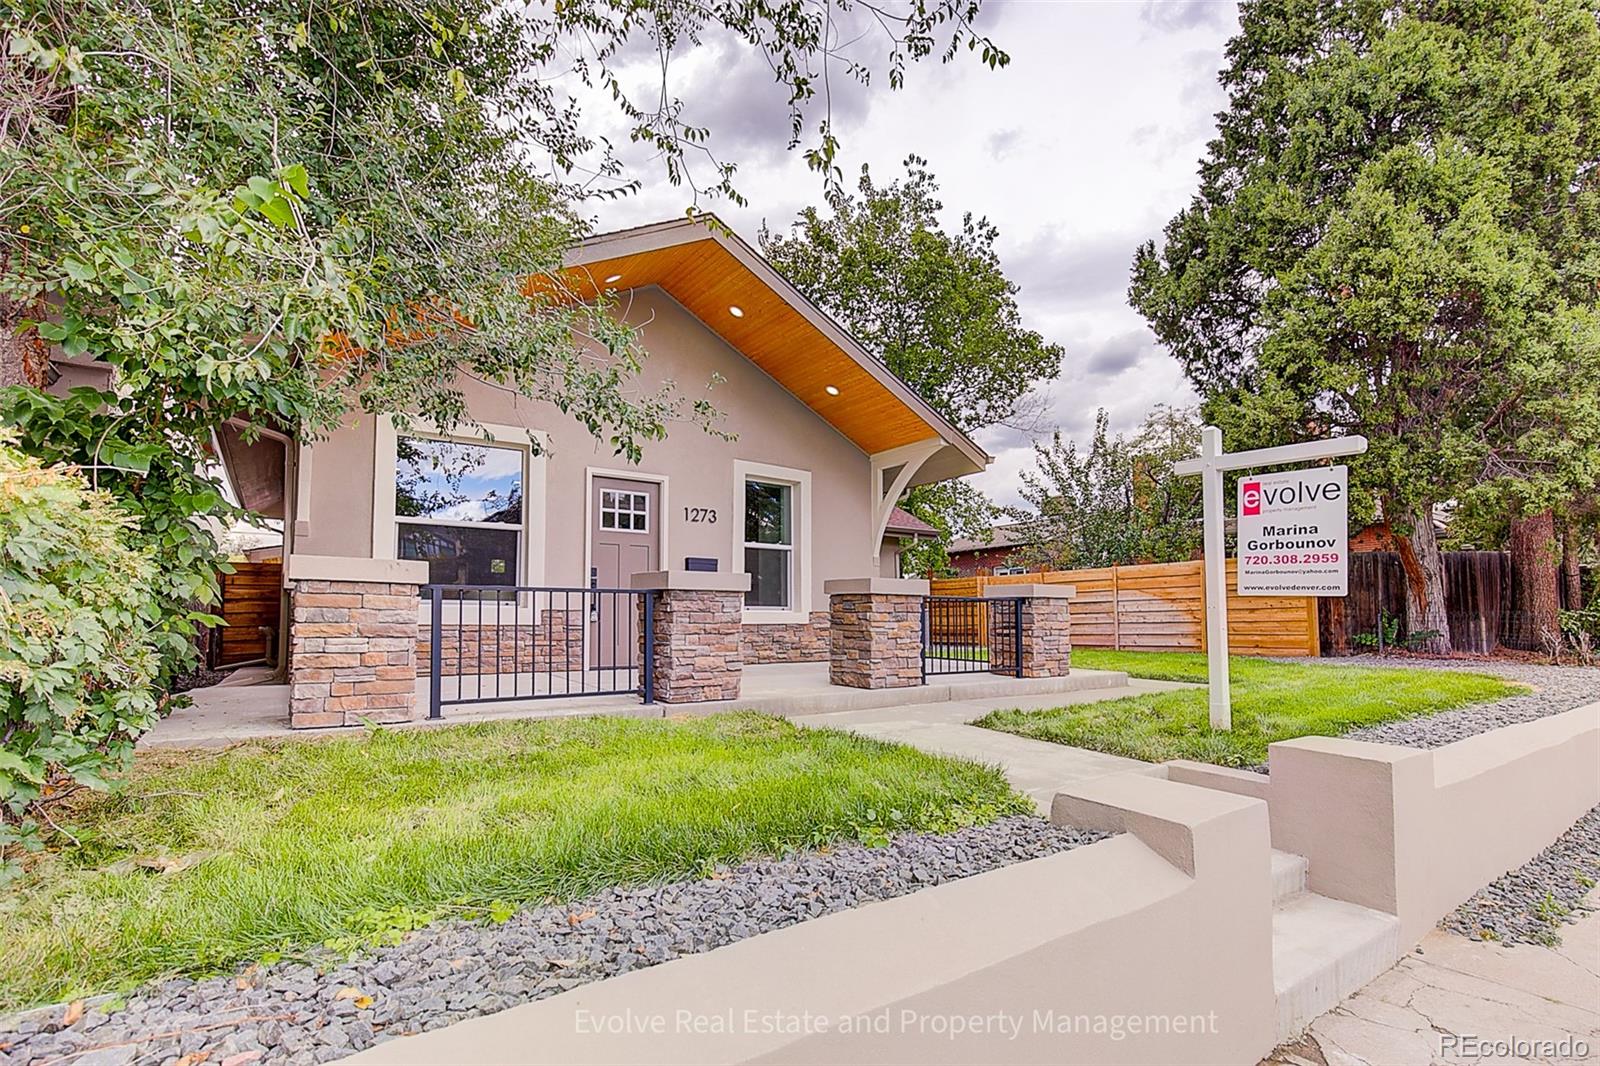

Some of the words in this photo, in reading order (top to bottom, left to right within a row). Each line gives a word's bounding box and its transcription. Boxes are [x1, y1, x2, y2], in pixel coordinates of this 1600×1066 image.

[1244, 481, 1341, 508] evolve
[684, 507, 716, 523] 1273
[1262, 524, 1318, 537] Marina
[1247, 539, 1336, 551] Gorbounov
[1244, 553, 1339, 565] 720.308.2959
